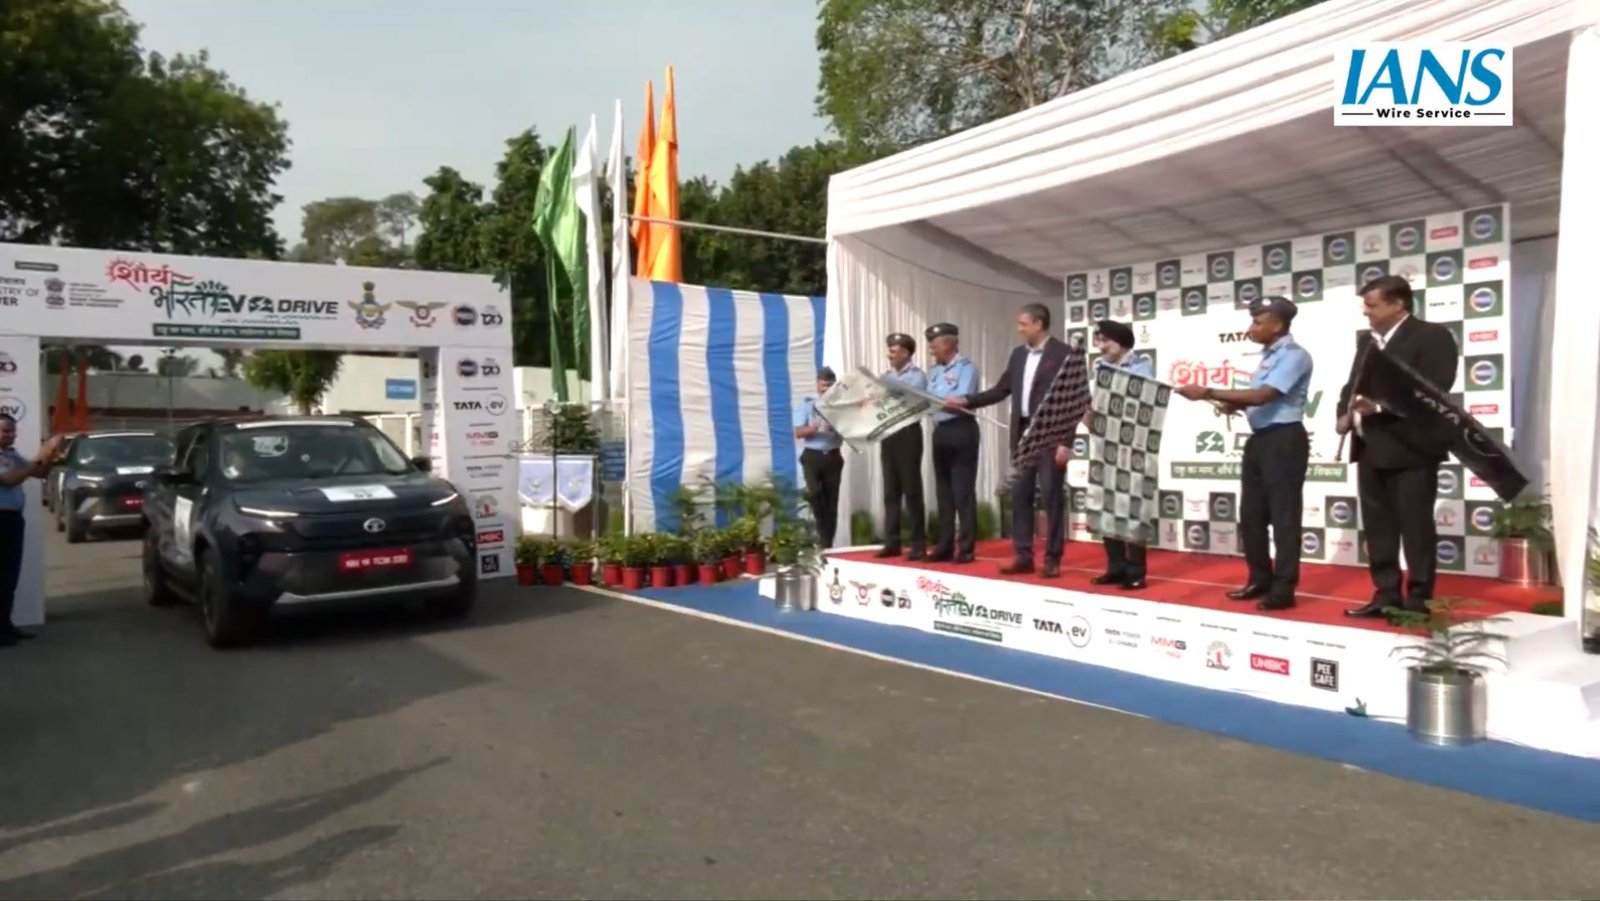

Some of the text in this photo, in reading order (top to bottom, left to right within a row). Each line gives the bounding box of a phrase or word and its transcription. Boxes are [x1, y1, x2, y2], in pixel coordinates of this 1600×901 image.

[278, 300, 338, 314] DRIVE
[453, 401, 482, 411] TATA
[989, 609, 1022, 624] DRIVE
[1033, 618, 1063, 634] TATA
[1316, 662, 1331, 675] PEE
[1314, 673, 1335, 687] SAFE
